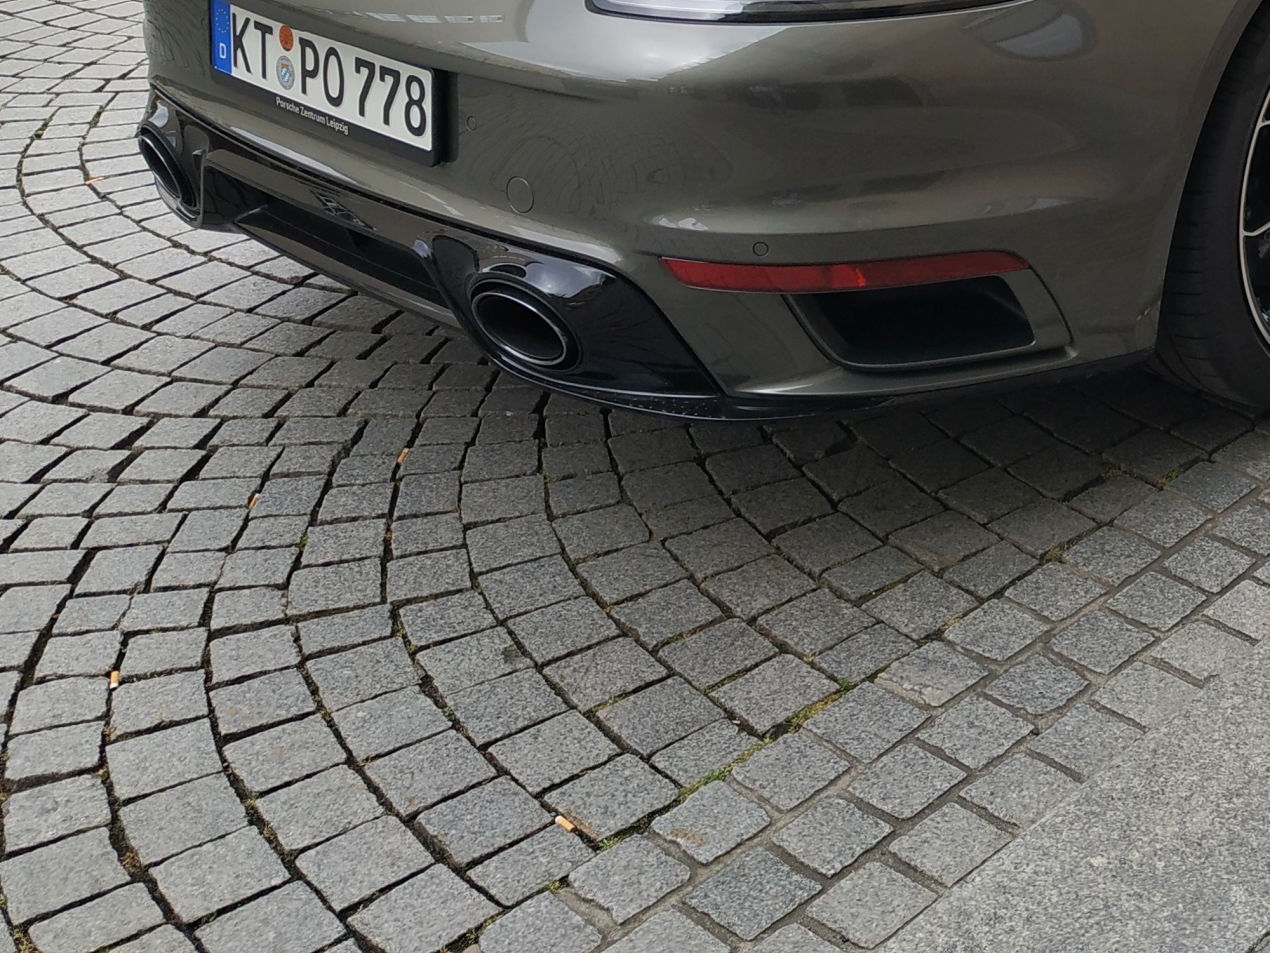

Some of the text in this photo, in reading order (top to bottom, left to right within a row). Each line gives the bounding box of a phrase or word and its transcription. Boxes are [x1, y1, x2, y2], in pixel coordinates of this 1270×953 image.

[219, 42, 227, 59] D
[232, 12, 274, 80] KT
[275, 96, 349, 135] Porsche Zentrum Leipzig
